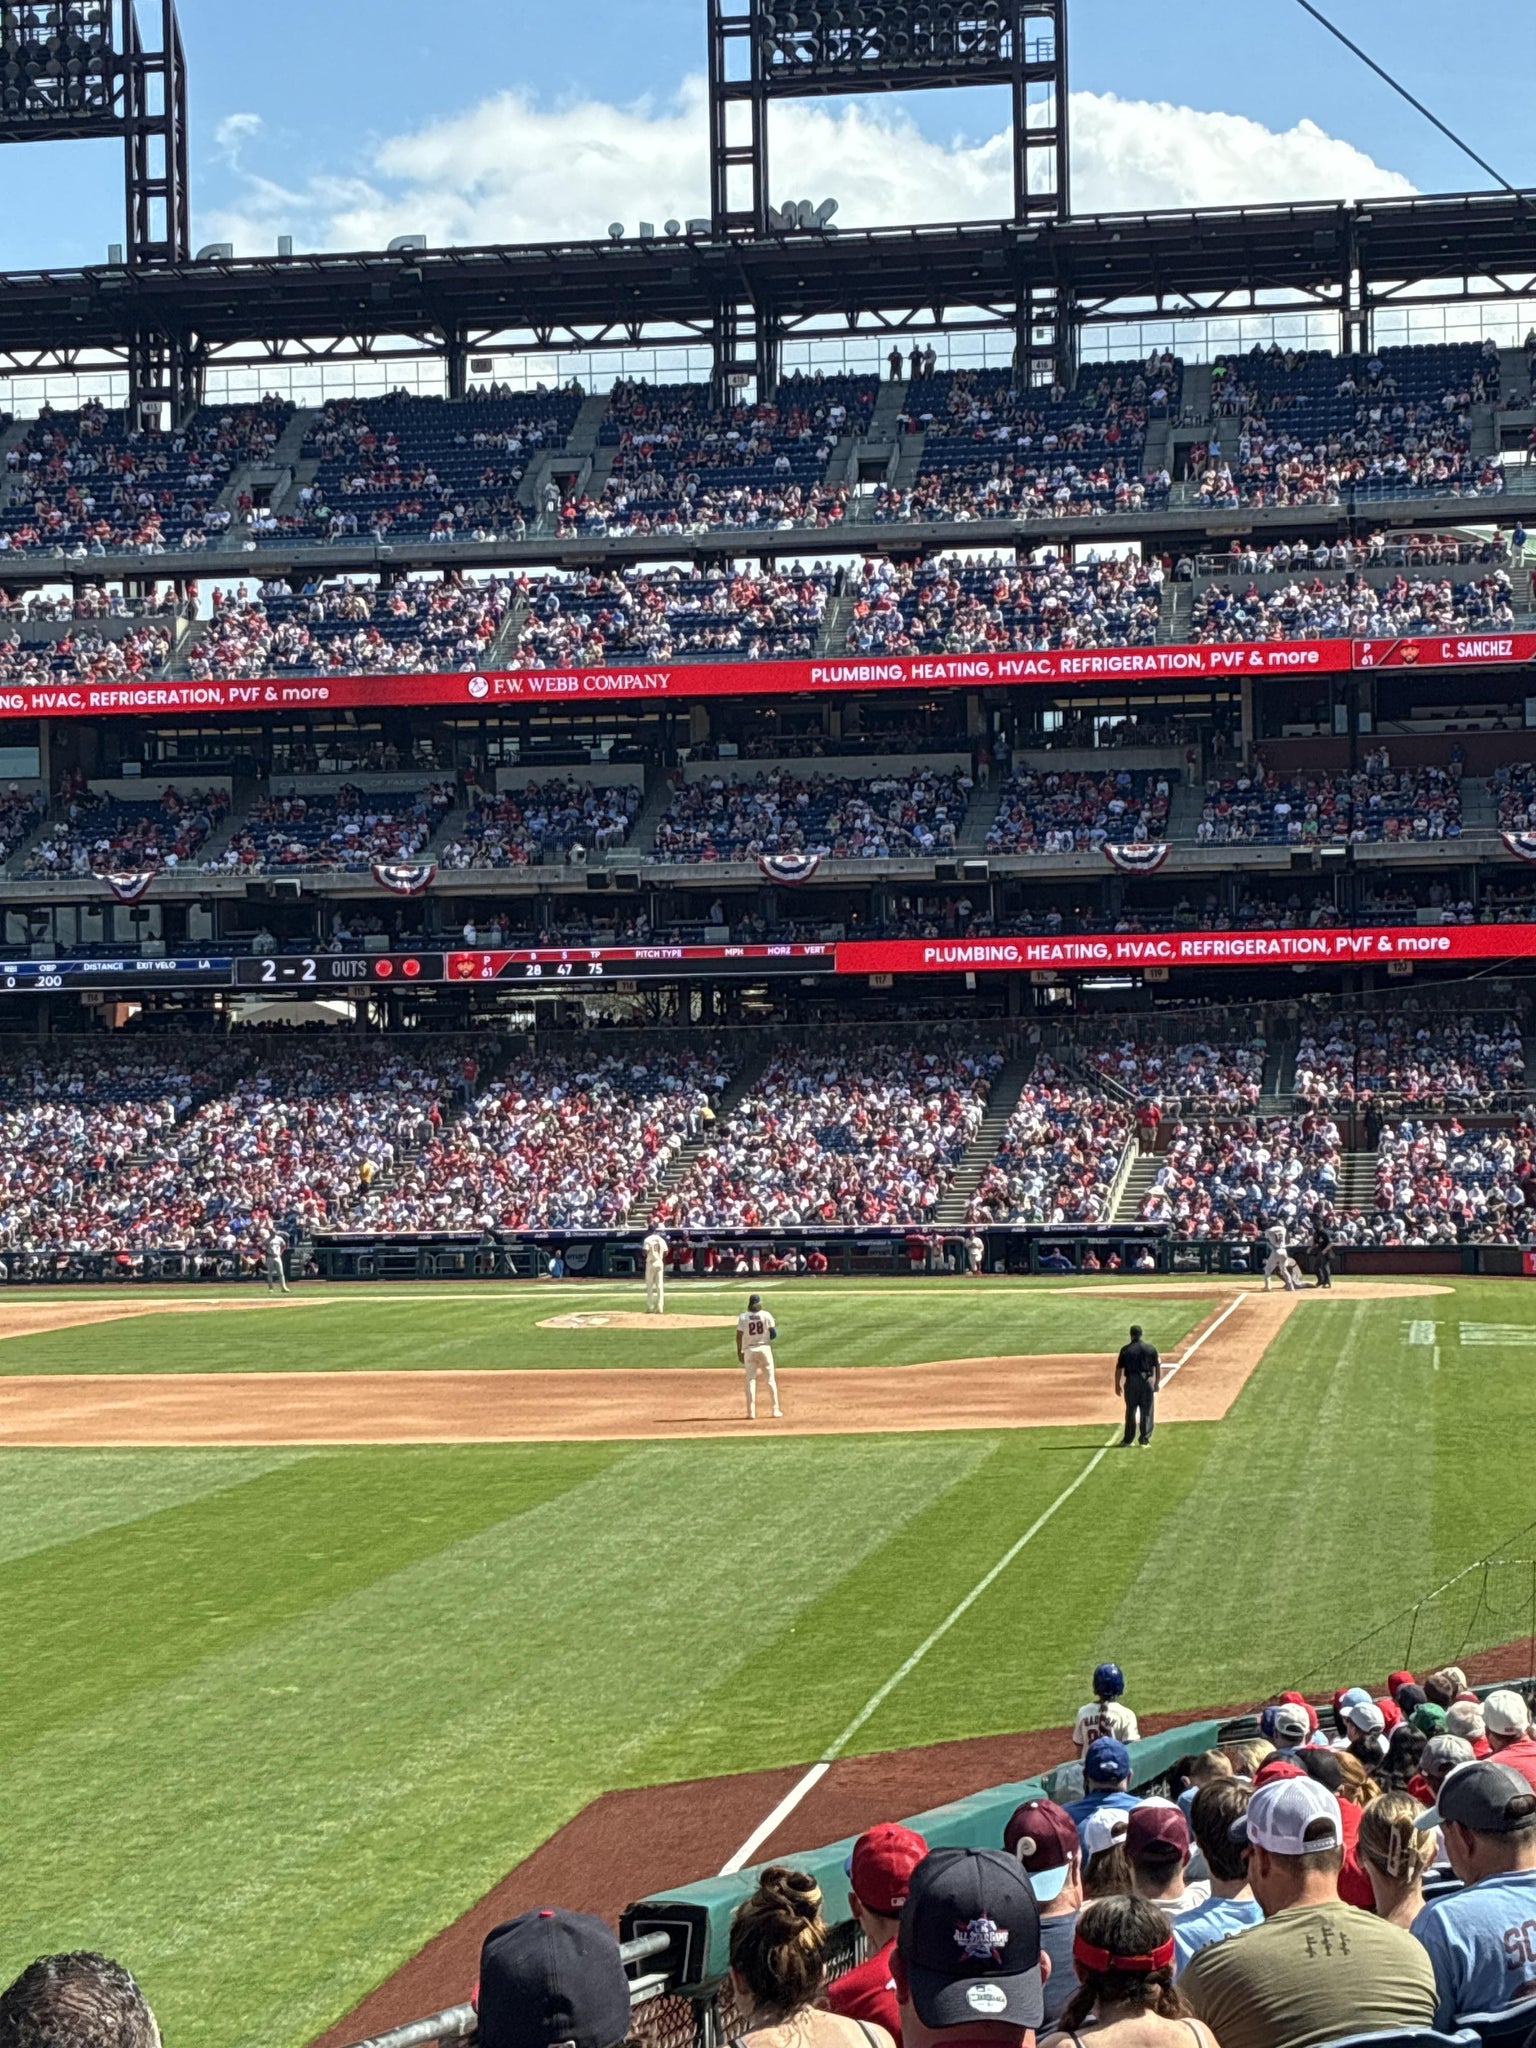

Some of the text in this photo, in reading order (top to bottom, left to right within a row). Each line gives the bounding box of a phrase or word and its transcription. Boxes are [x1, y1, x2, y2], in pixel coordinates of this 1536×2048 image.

[1363, 643, 1371, 653] P
[1442, 640, 1513, 658] C. SANCHEZ
[1361, 655, 1374, 665] 61
[811, 650, 1319, 683] PLUMBING, HEATING, HVAC, REFRIGERATION, PVF & more
[494, 673, 671, 694] F.W. WEBB COMPANY
[31, 692, 86, 710] HVAC,
[90, 687, 225, 707] REFRIGERATION,
[229, 687, 260, 702] PVF
[265, 687, 279, 701] &
[282, 687, 329, 701] more
[635, 949, 682, 959] PITCH TYPE
[724, 948, 744, 957] MPH
[804, 946, 825, 955] VERT
[924, 935, 1450, 963] PLUMBING, HEATING, HVAC, REFRIGERATION, PVF & more
[83, 962, 124, 971] DISTANCE
[136, 961, 176, 970] EXIT VELO
[199, 960, 210, 969] LA
[483, 956, 491, 966] P
[332, 960, 368, 978] OUTS
[481, 967, 493, 978] 61
[526, 964, 542, 977] 28
[557, 964, 572, 976] 47
[588, 963, 603, 975] 75
[7, 976, 16, 988] 0
[34, 975, 62, 987] .200
[749, 1321, 764, 1336] 28
